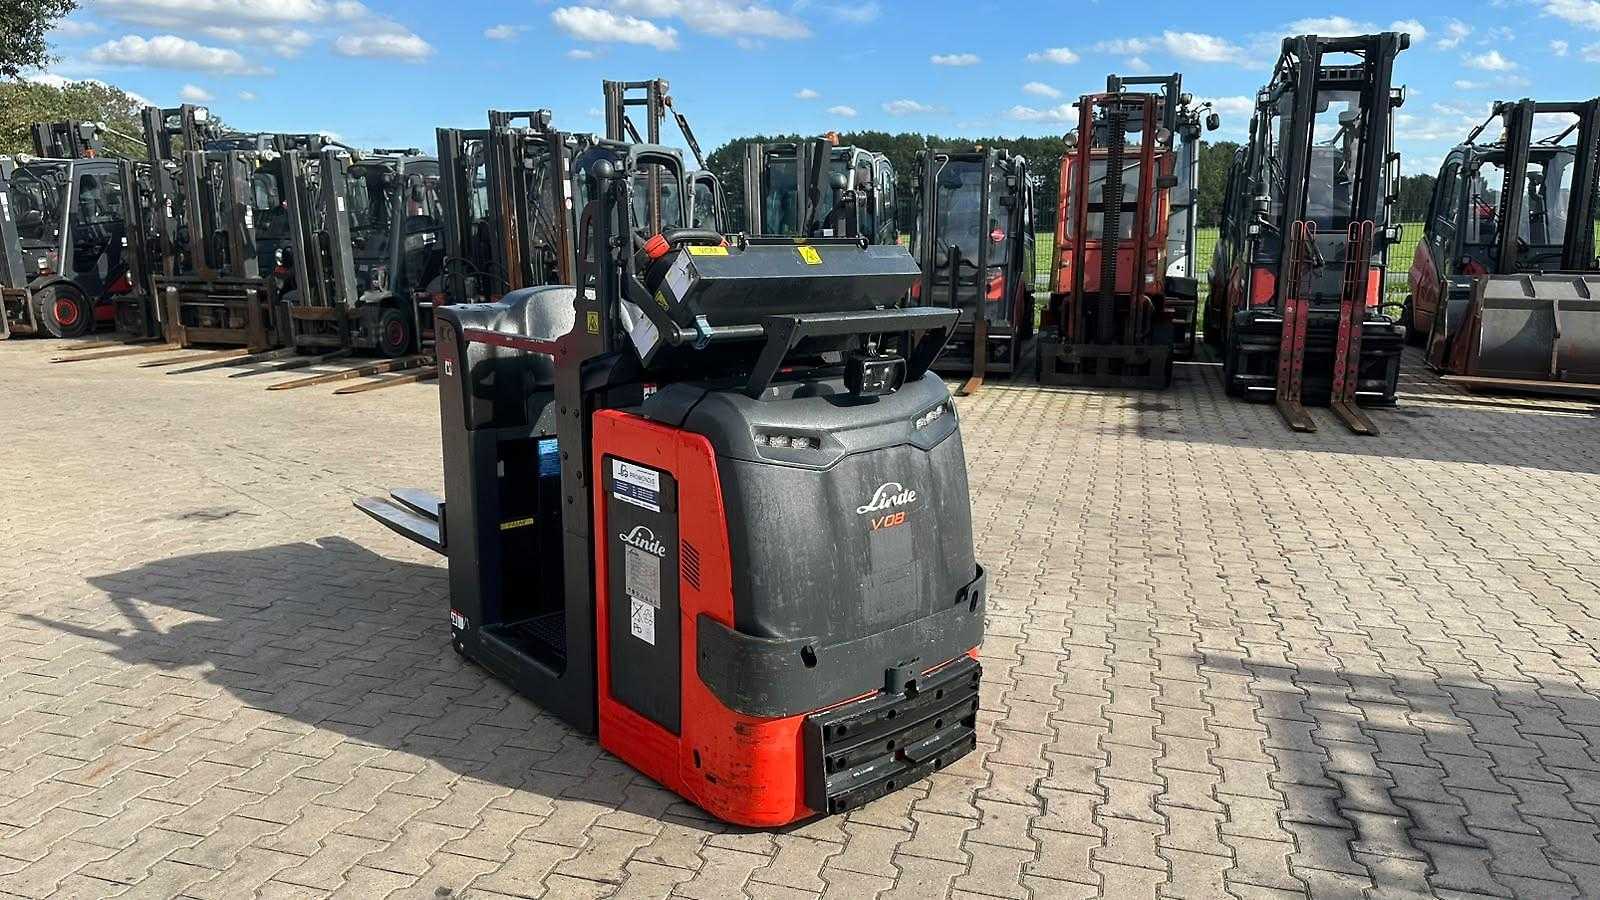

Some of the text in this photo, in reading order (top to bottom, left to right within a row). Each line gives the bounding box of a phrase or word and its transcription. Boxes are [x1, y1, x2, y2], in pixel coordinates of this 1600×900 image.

[856, 482, 917, 514] Linde
[871, 511, 906, 530] V08
[619, 525, 666, 557] Linde
